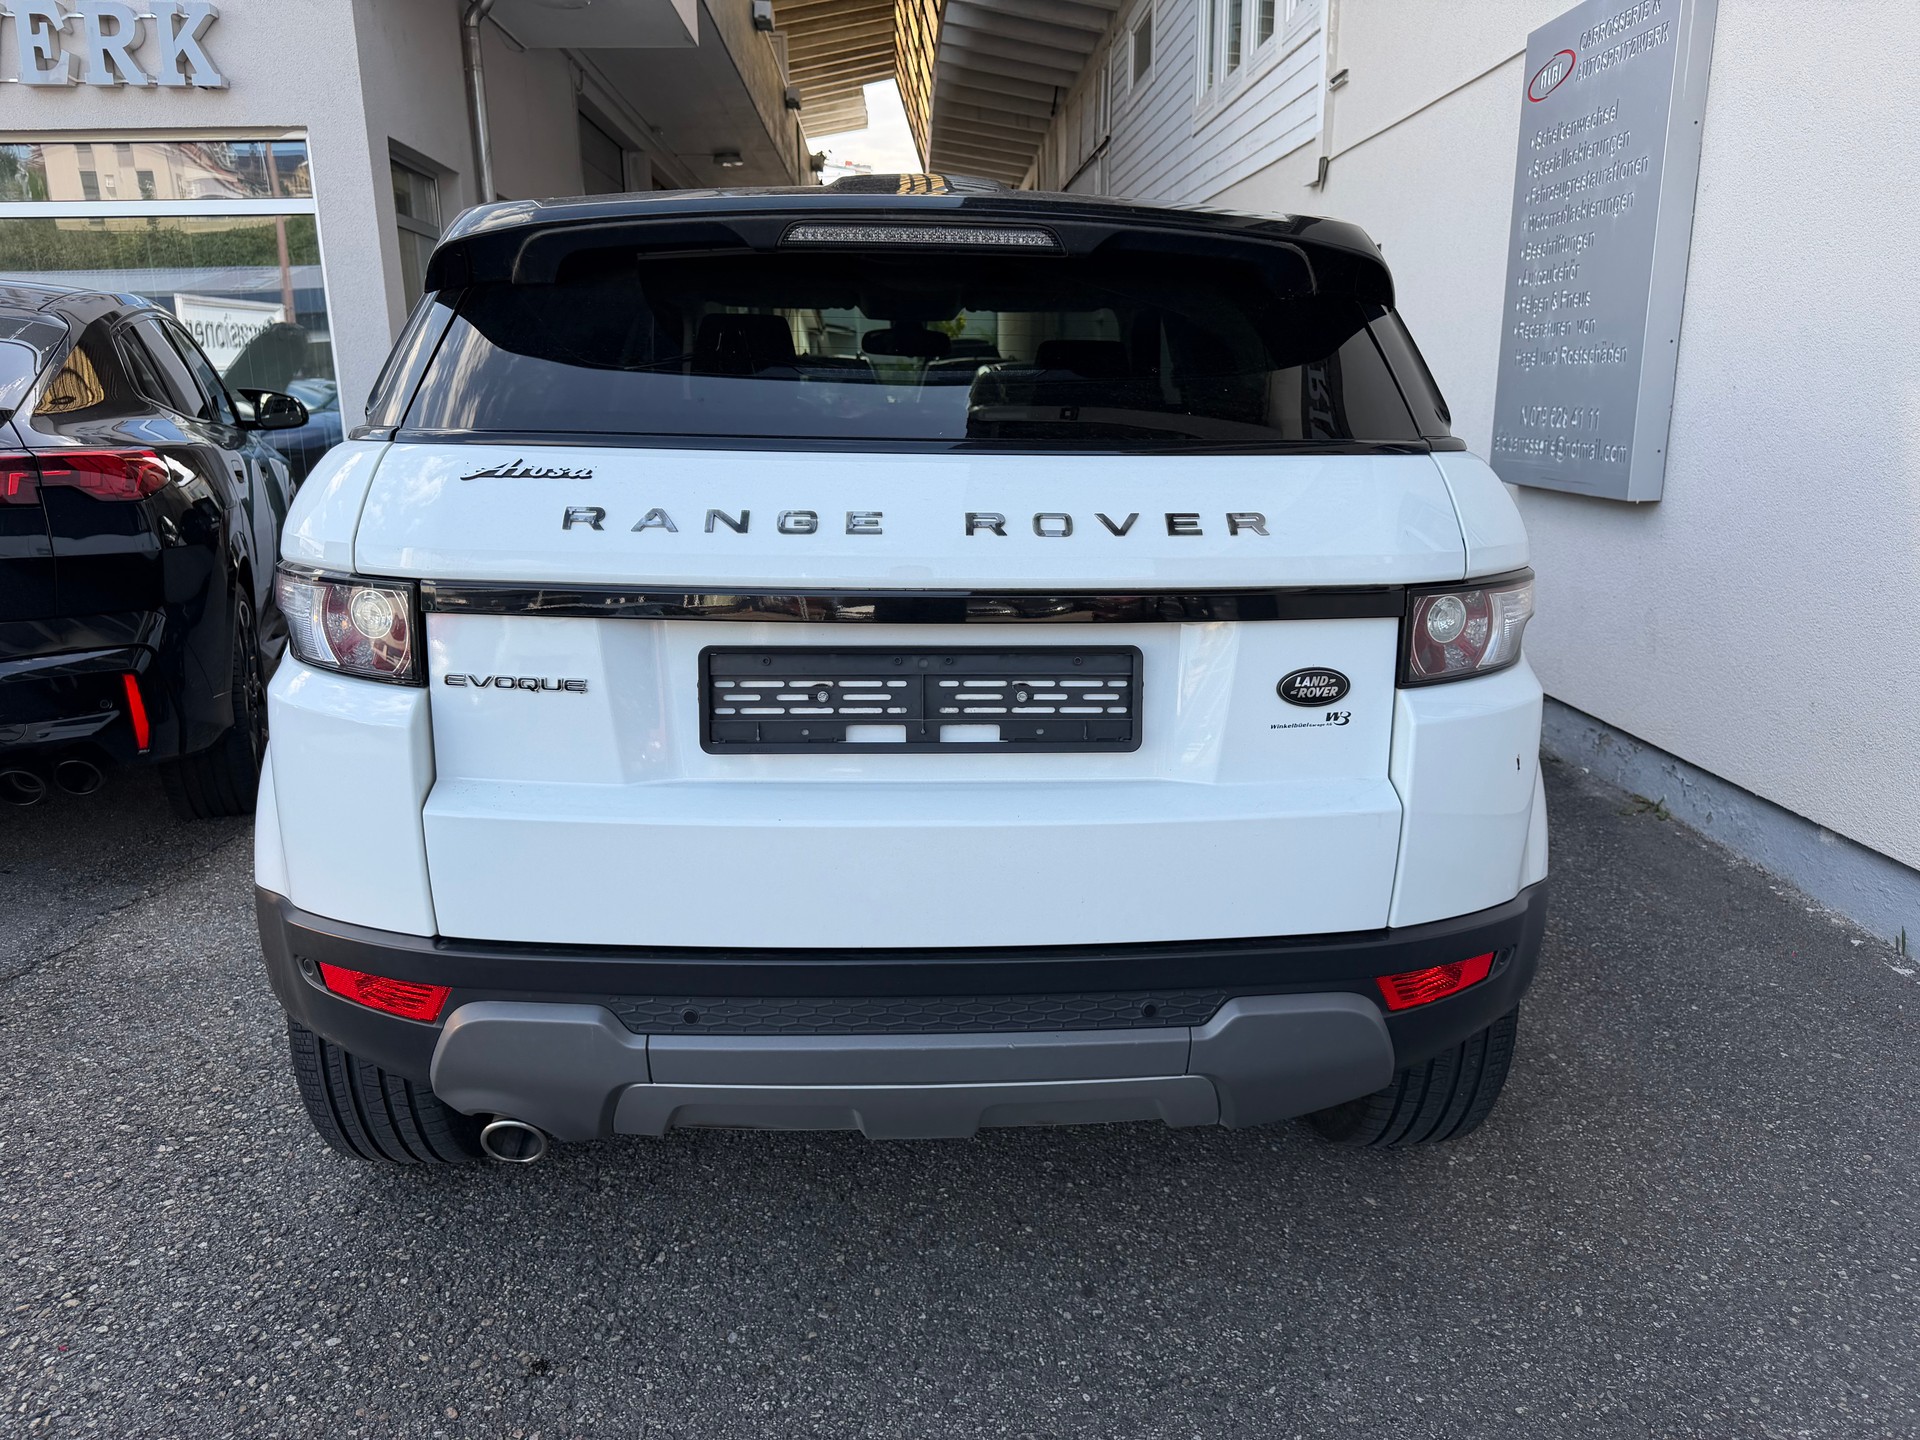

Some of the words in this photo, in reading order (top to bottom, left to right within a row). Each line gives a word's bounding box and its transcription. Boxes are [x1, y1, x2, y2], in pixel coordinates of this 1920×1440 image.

[1579, 0, 1650, 52] CARROSSERIE
[0, 0, 230, 89] ERK
[1575, 20, 1670, 82] AUTOSPRITZWERK
[1532, 130, 1631, 179] Speziallackierungen
[1529, 155, 1649, 205] Fahrzeugrestaurationen
[1528, 191, 1635, 232] Motorradlackierungen
[1525, 231, 1595, 260] Beschriftungen
[1522, 259, 1580, 287] Autozubehör
[1520, 295, 1549, 318] Felgen
[1551, 290, 1558, 311] &
[1560, 289, 1591, 309] Pneus
[1518, 320, 1572, 341] Reparaturen
[1577, 318, 1596, 335] von
[1560, 340, 1628, 365] Rostschäden
[562, 506, 883, 535] RANGE
[964, 512, 1270, 538] ROVER
[444, 673, 588, 694] EVOQUE
[1295, 675, 1328, 687] LAND
[1297, 686, 1339, 698] ROVER
